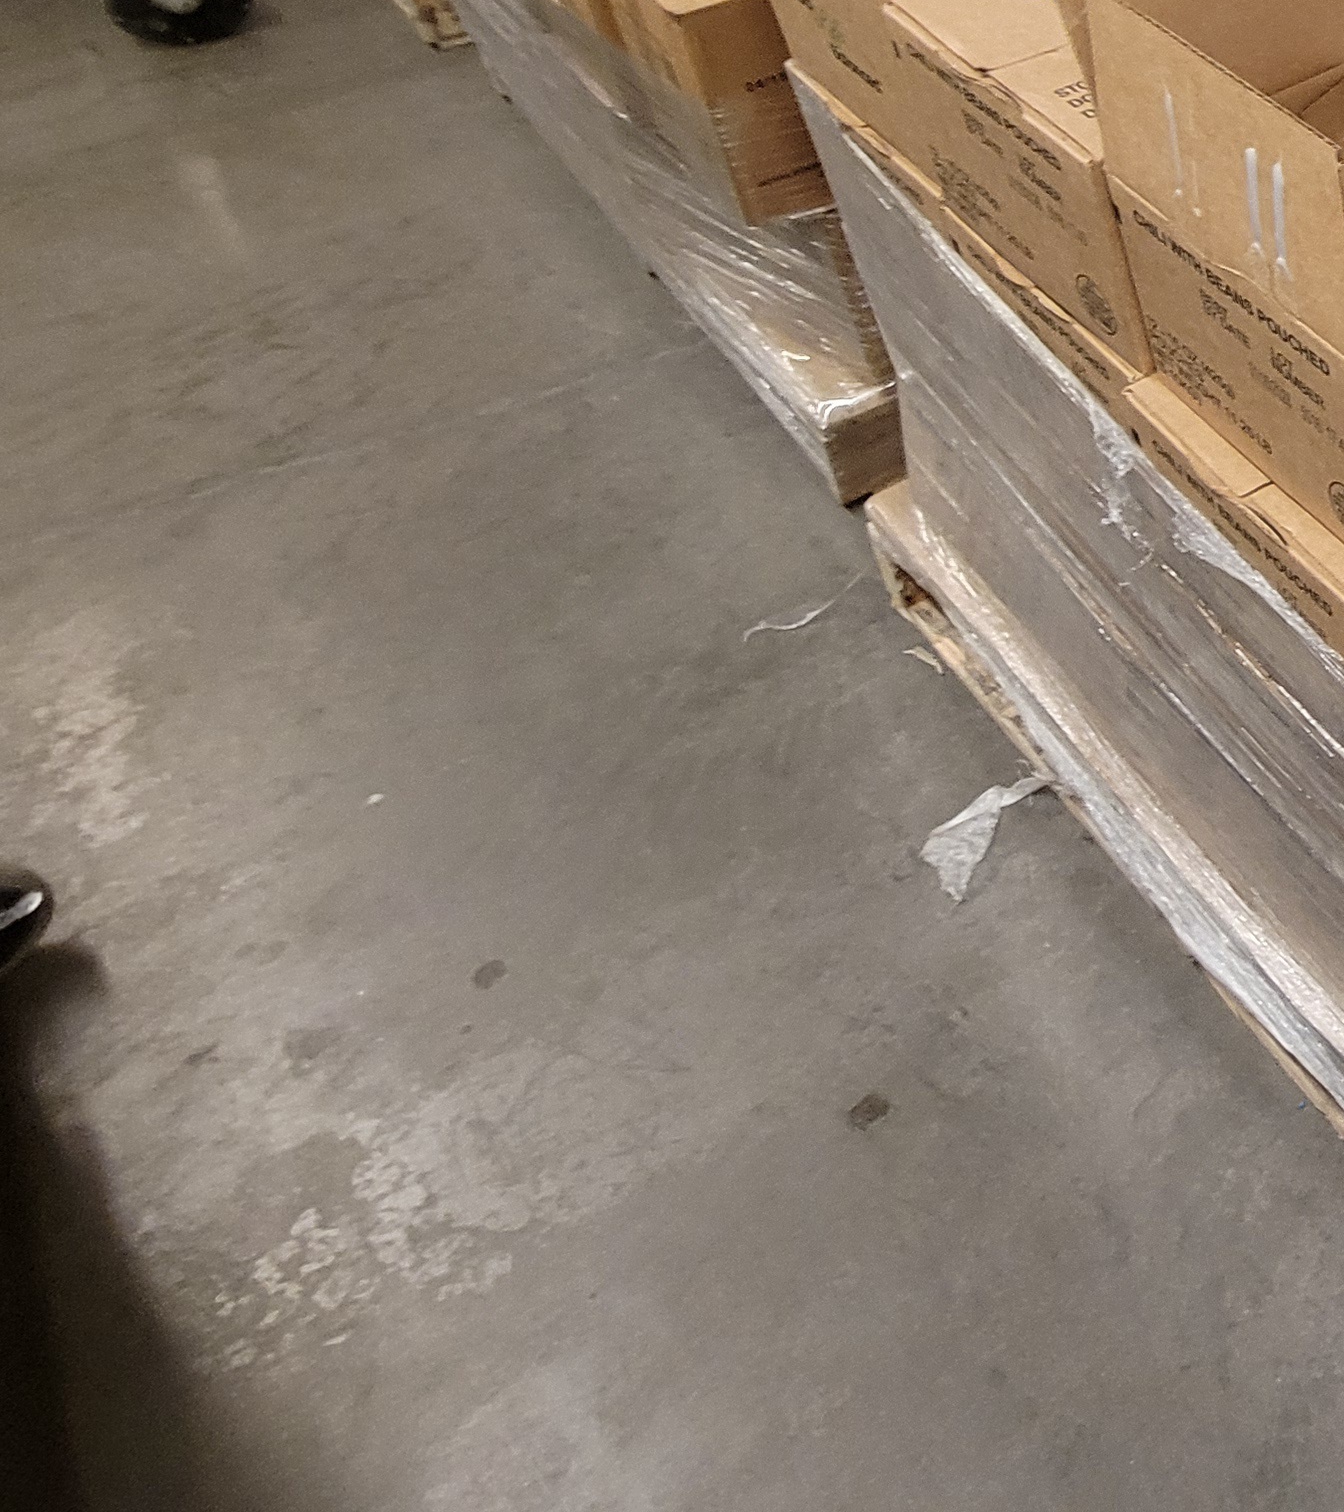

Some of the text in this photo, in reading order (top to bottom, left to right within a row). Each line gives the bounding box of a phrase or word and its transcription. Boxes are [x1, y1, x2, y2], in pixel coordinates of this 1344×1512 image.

[1204, 266, 1255, 317] BEANS
[1256, 307, 1332, 377] POUCHED
[1263, 546, 1334, 618] POUCHED
